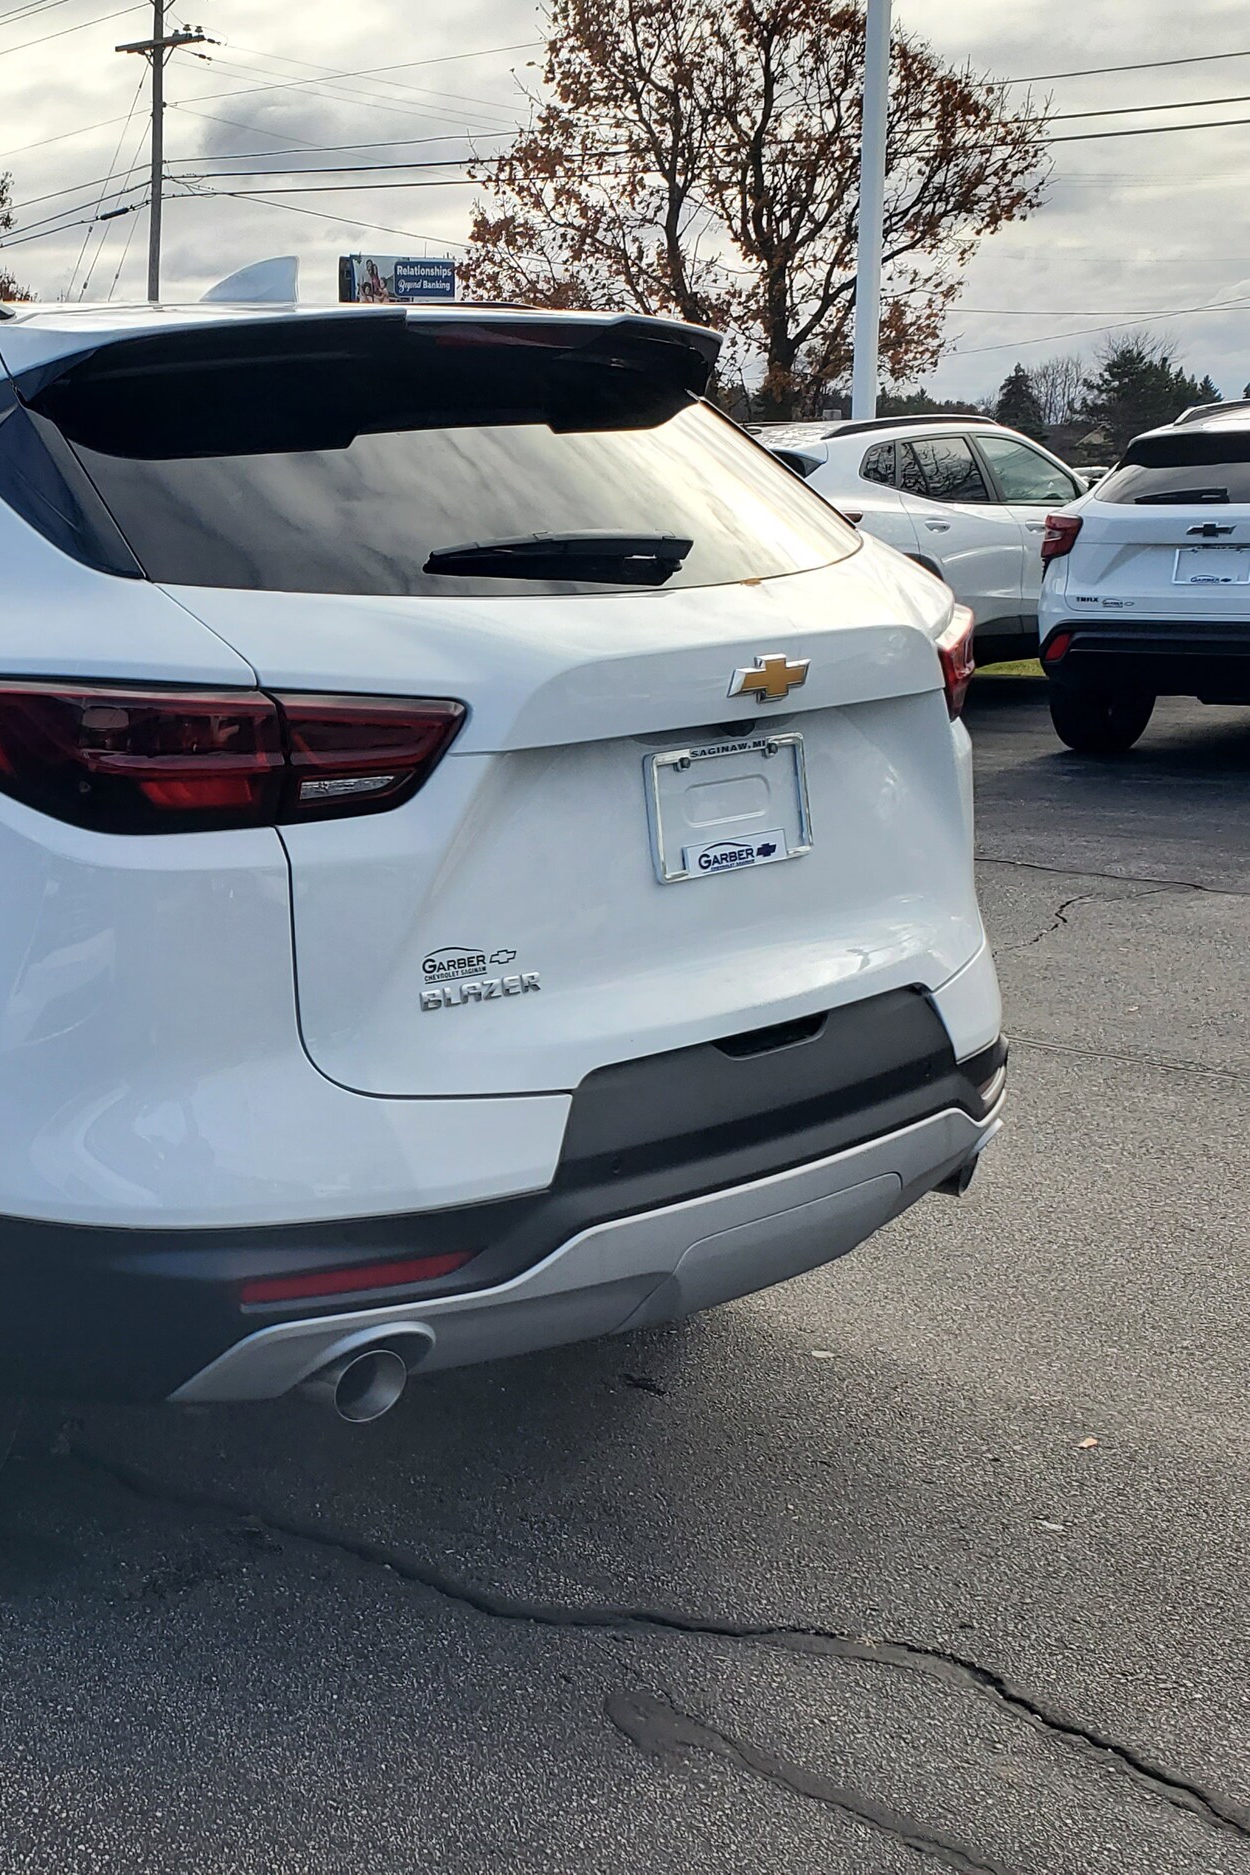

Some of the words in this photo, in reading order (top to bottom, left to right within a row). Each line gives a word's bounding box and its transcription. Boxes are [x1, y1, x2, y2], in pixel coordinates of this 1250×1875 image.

[396, 264, 452, 279] Relationships
[422, 280, 450, 291] Banking
[698, 847, 755, 870] GARBER
[422, 954, 487, 974] GARBER
[419, 971, 541, 1012] BLAZER
